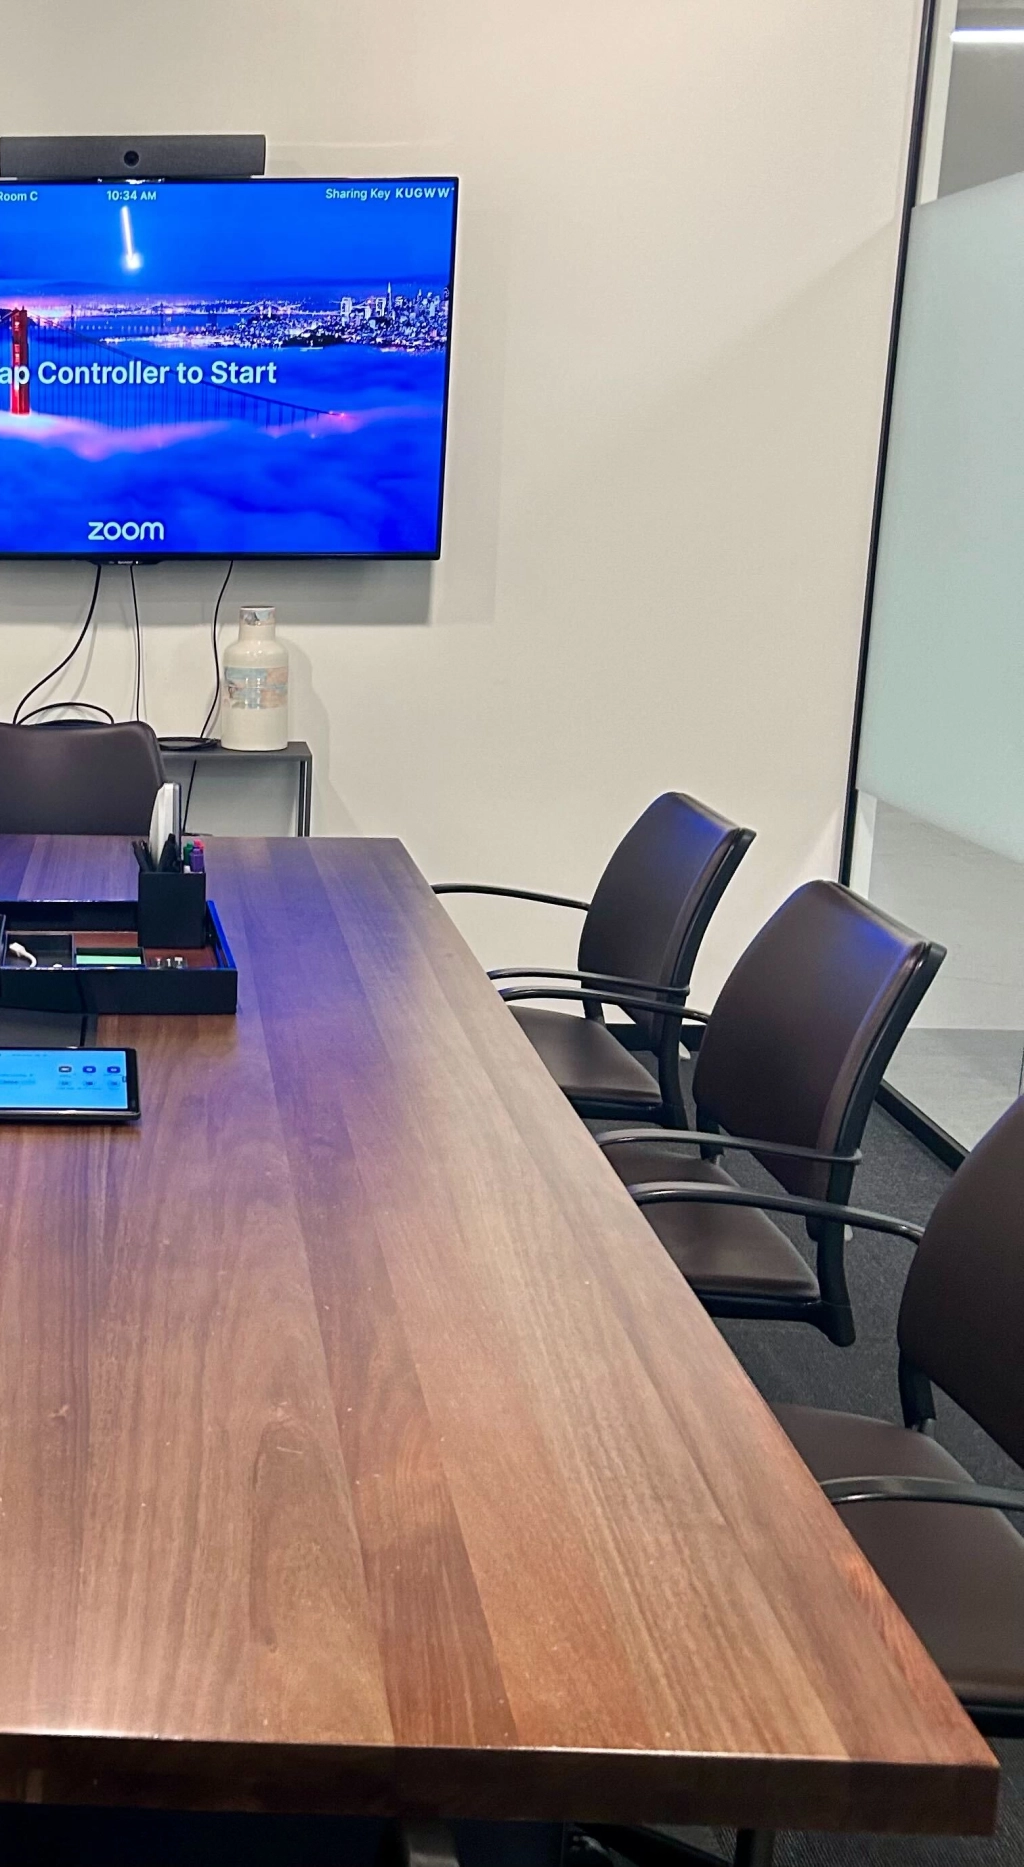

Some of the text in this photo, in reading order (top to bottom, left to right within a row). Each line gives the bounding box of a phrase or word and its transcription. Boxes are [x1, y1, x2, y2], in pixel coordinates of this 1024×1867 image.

[29, 191, 38, 201] C
[107, 190, 157, 200] 10:34 AM
[325, 188, 368, 201] Sharing
[370, 188, 391, 201] Key
[38, 360, 170, 384] Controller
[176, 362, 203, 384] to
[211, 360, 277, 384] Start
[88, 521, 164, 540] zoom
